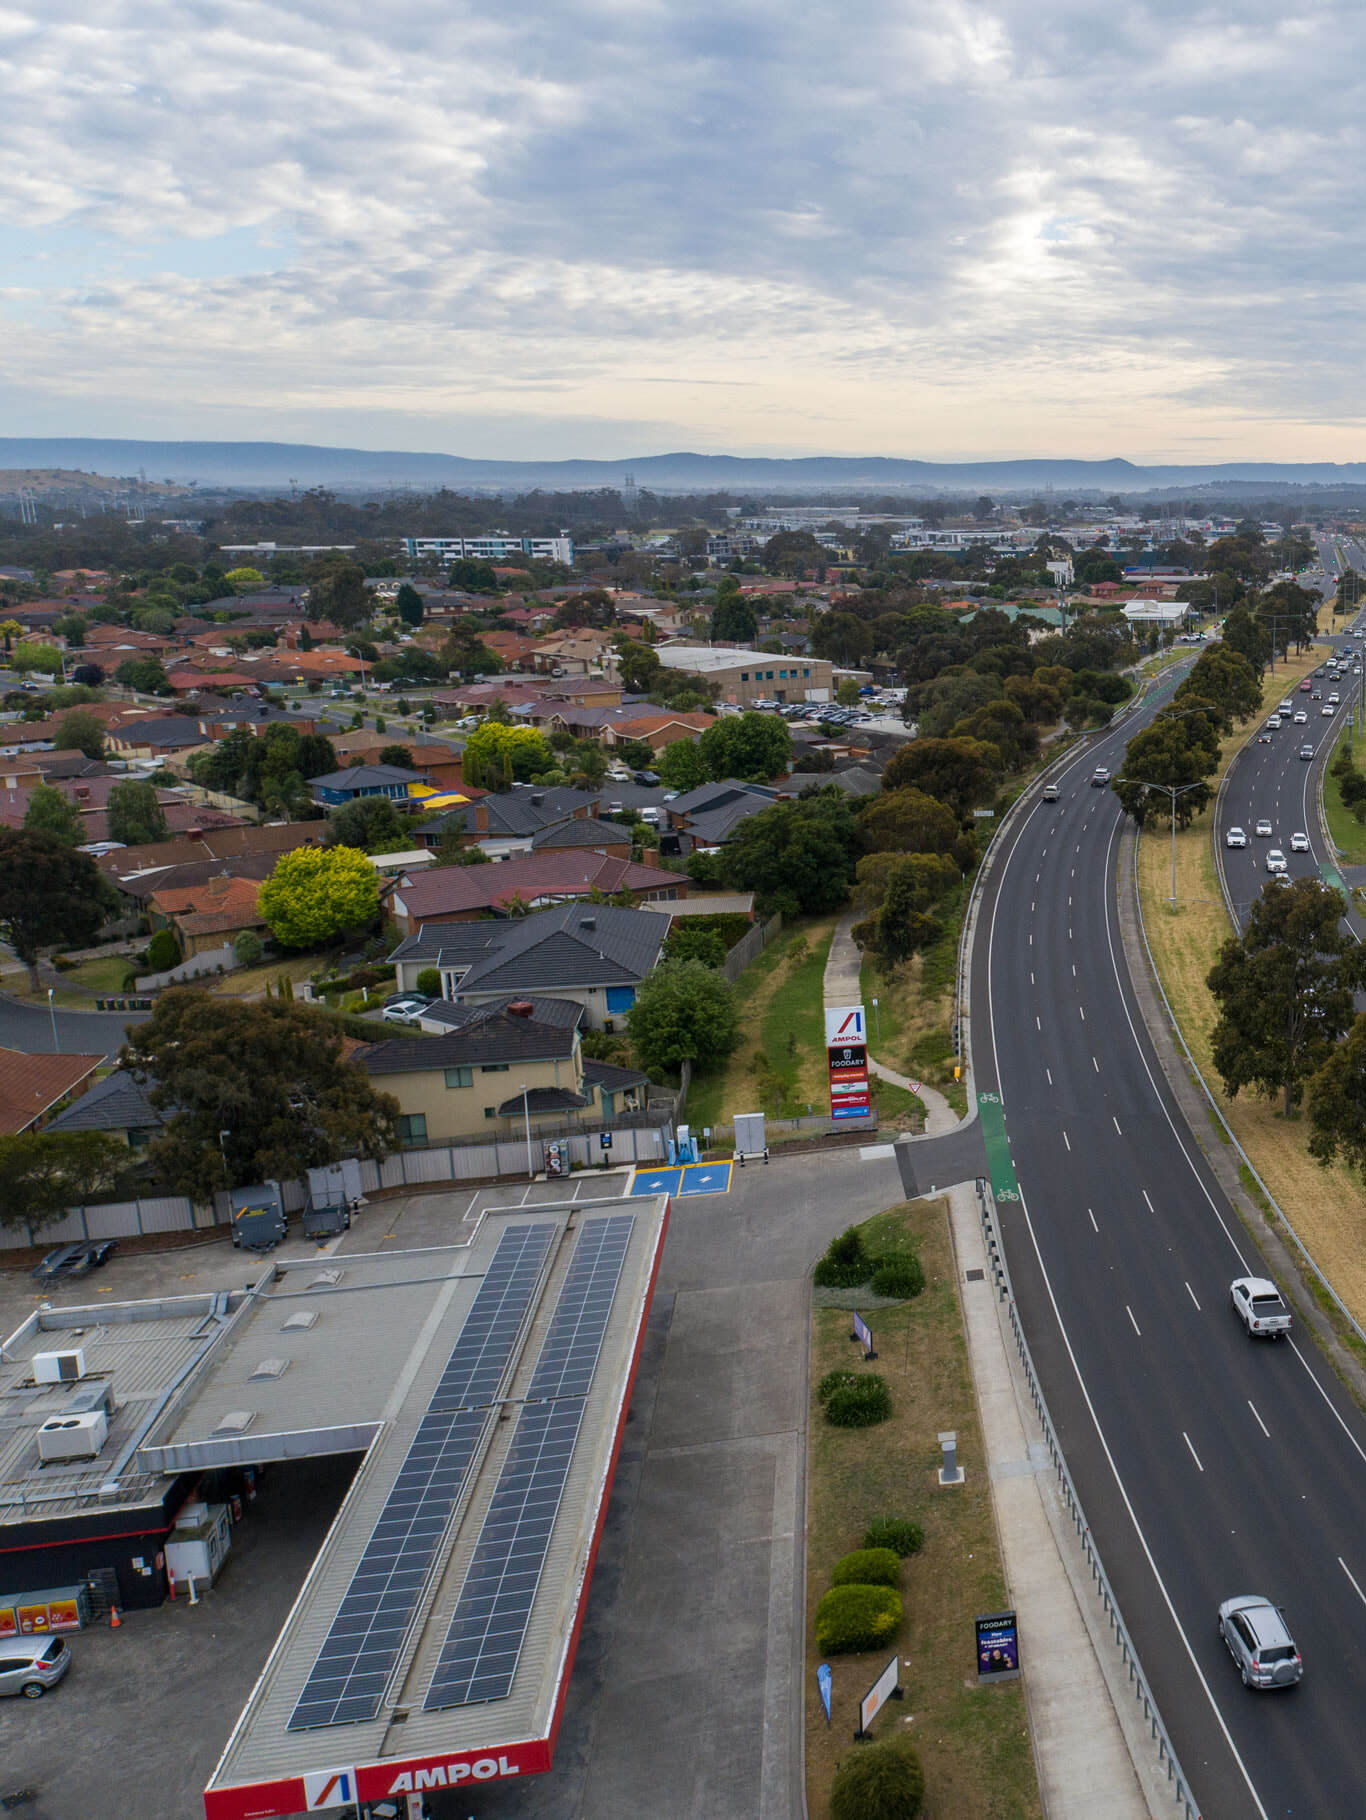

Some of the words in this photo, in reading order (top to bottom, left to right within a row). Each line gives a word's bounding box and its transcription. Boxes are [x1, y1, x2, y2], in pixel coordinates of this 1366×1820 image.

[831, 1059, 864, 1067] FOODARY
[980, 1620, 1012, 1630] FOODARY
[388, 1756, 519, 1794] AMPOL
